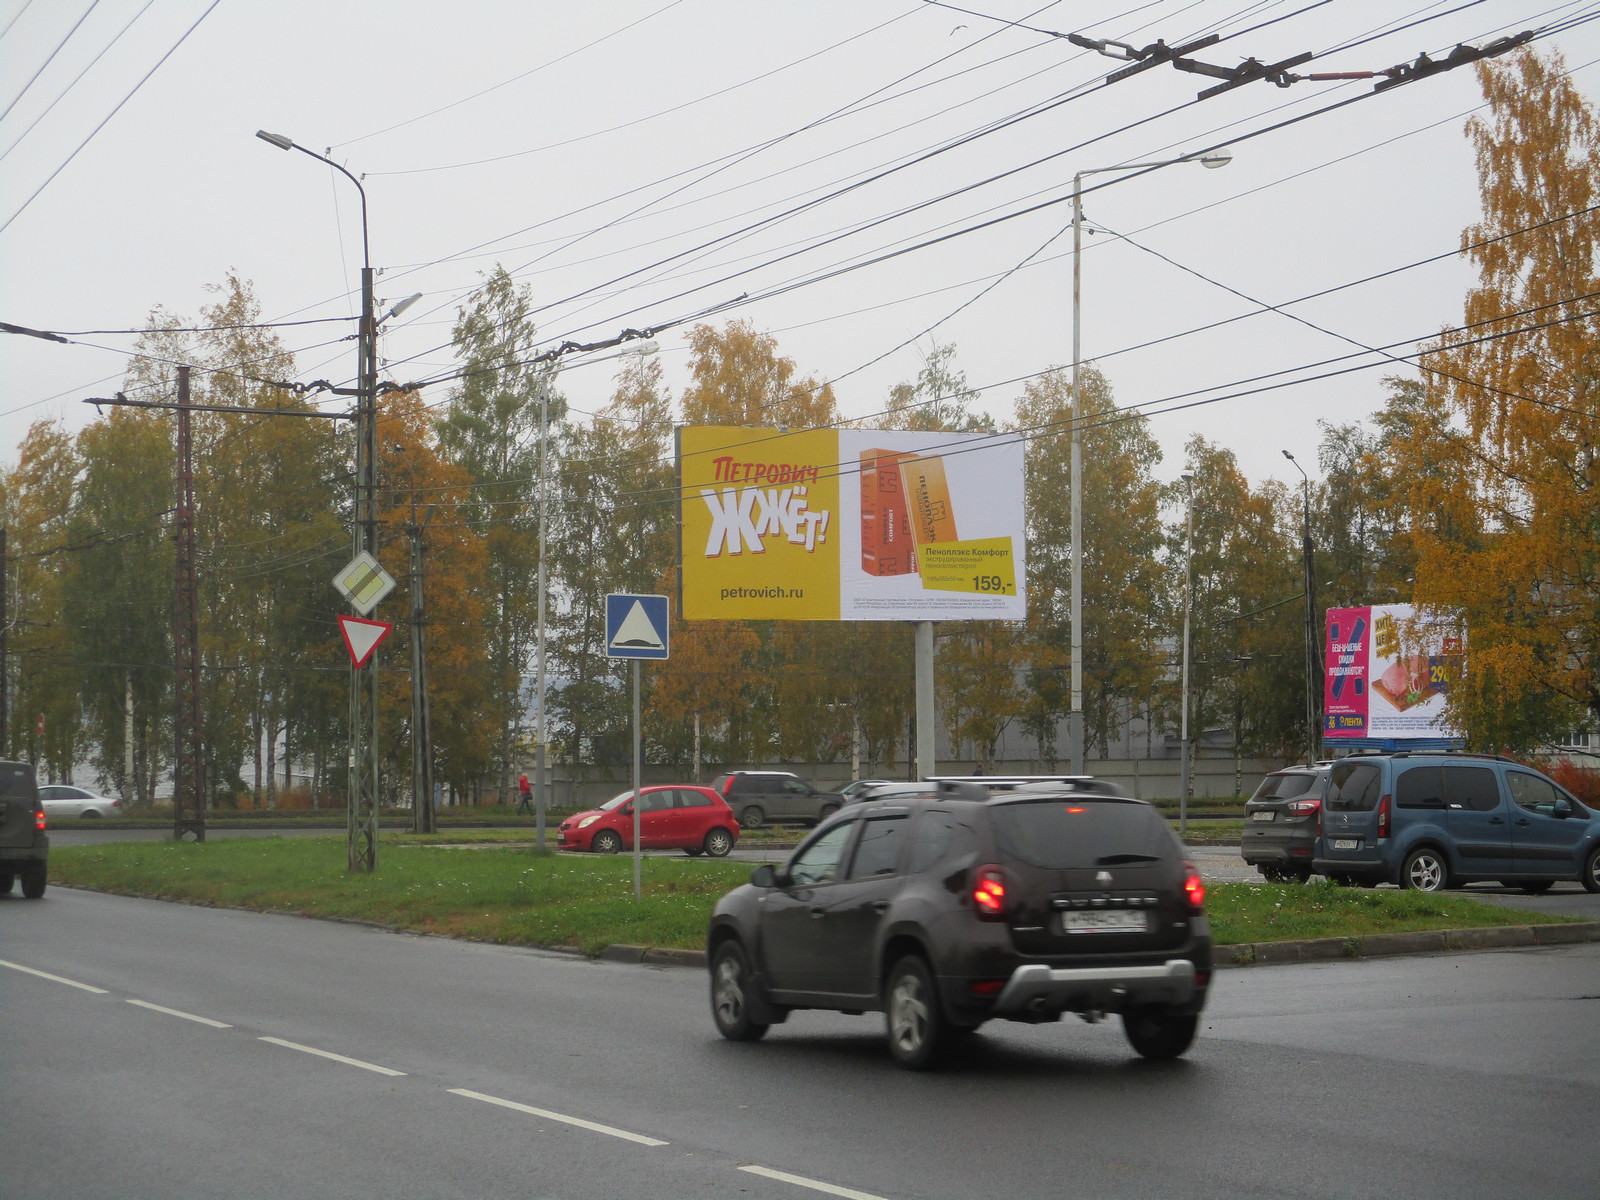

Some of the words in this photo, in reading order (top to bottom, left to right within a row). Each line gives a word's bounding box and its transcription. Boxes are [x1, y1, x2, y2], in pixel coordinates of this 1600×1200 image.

[700, 485, 830, 558] ЖЖЁТ!
[925, 547, 970, 556] Пеноплэкс
[972, 548, 1009, 557] Комфорт
[972, 576, 1012, 594] 159,-
[720, 586, 804, 600] petrovich.ru
[1343, 717, 1363, 727] ЛЕНТА
